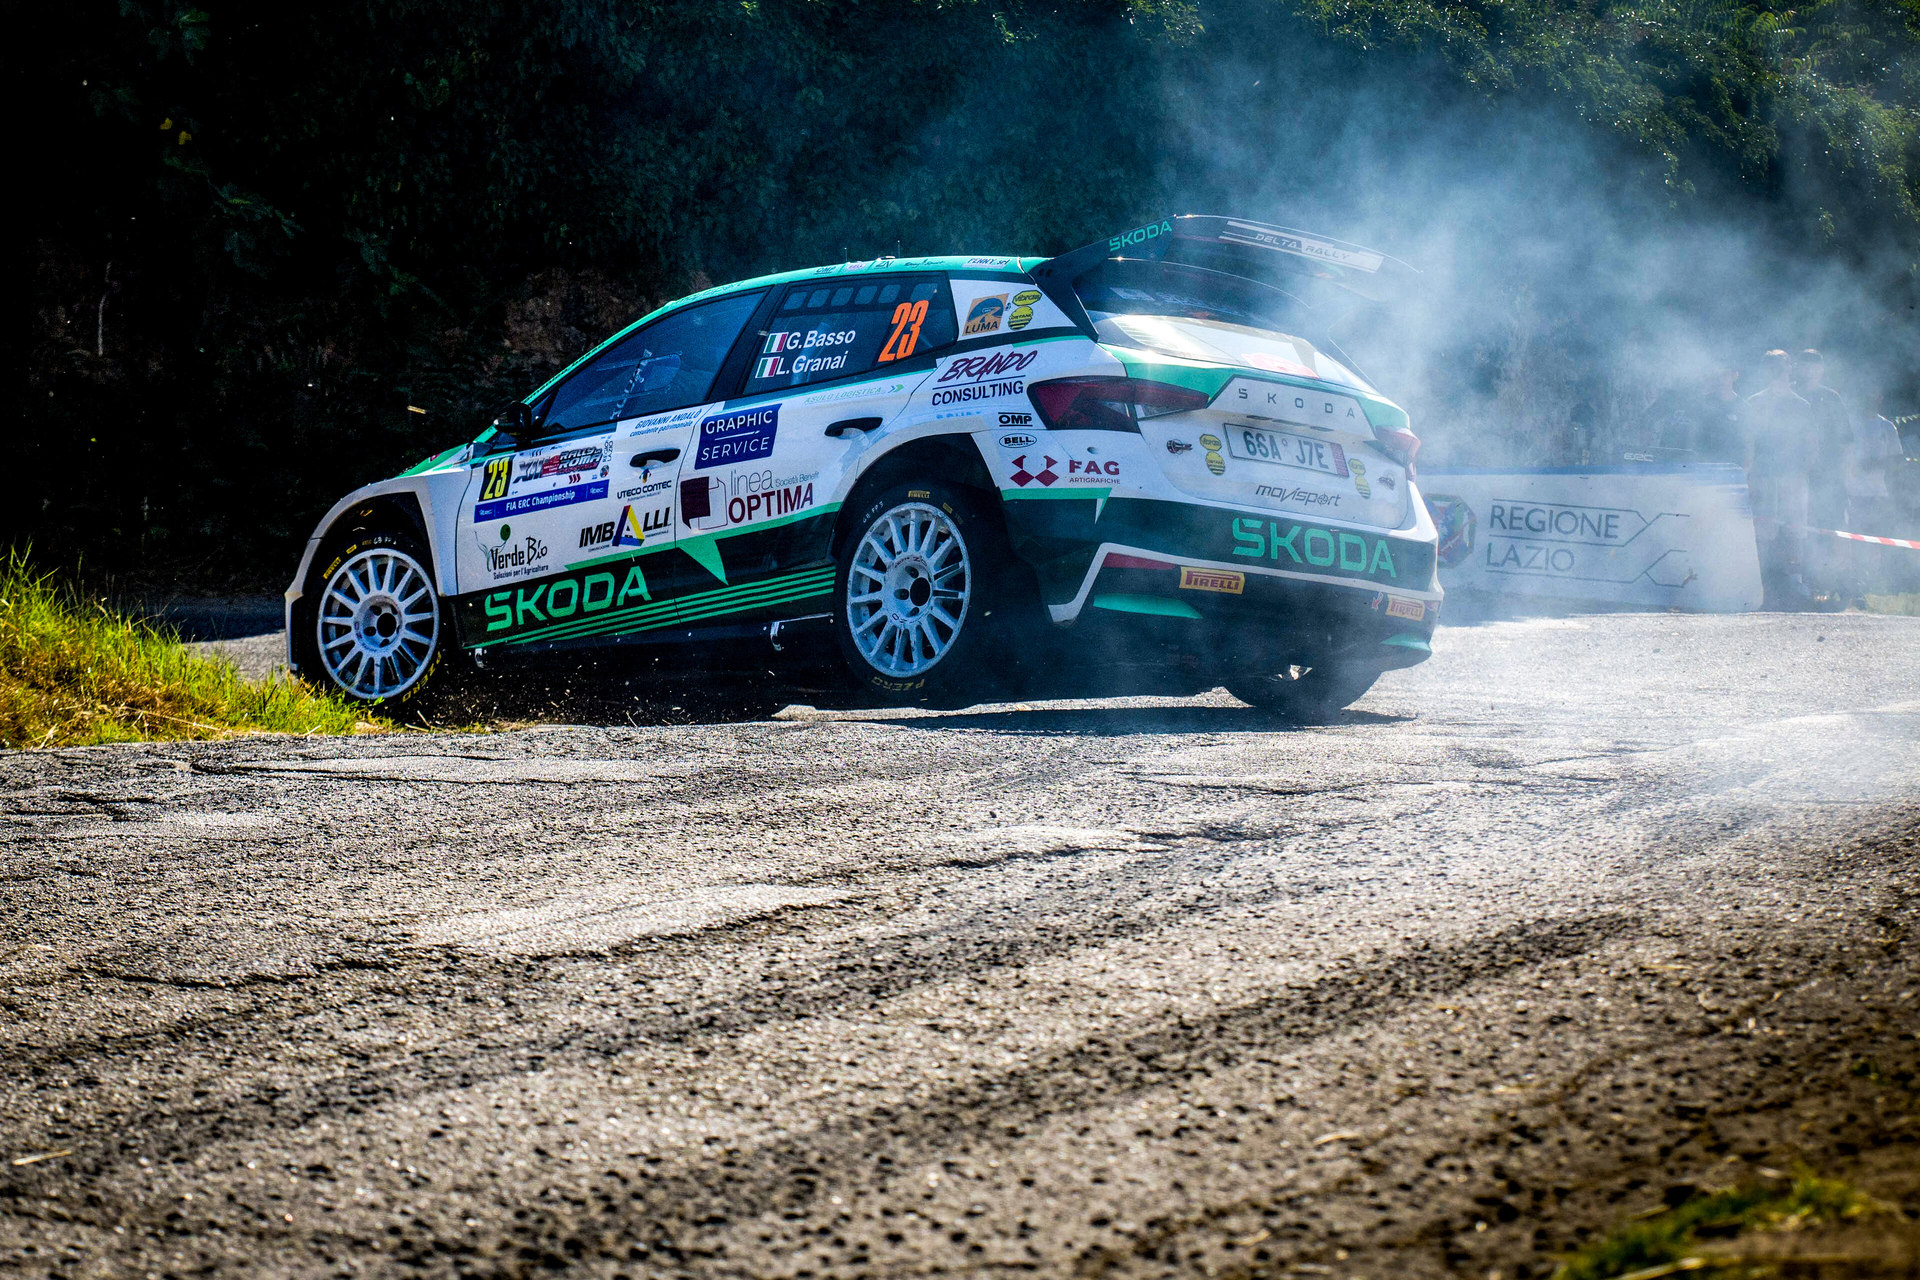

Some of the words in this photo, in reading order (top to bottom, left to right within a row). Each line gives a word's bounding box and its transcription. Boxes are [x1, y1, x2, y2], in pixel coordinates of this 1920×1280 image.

[1108, 220, 1173, 251] SKODA
[1255, 233, 1298, 248] DELTA
[1305, 245, 1351, 260] RALLY
[786, 329, 856, 351] G.Basso
[878, 299, 929, 363] 23
[965, 321, 998, 334] LUMA
[776, 351, 849, 376] L.Granai
[937, 350, 1038, 383] BRANDO
[932, 380, 1024, 406] CONSULTING
[1238, 388, 1356, 419] SKODA
[705, 410, 773, 435] GRAPHIC
[998, 413, 1033, 425] OMP
[560, 446, 597, 461] RALLY
[701, 436, 770, 461] SERVICE
[1004, 436, 1032, 445] BELL
[558, 454, 602, 470] ROMA
[1069, 460, 1120, 475] FAG
[483, 457, 507, 500] 23
[617, 487, 642, 500] UTECO
[642, 480, 672, 494] CONTEC
[731, 469, 773, 496] linea
[505, 501, 517, 511] FIA
[518, 498, 531, 509] ERC
[531, 490, 576, 506] Championship
[728, 482, 813, 523] OPTIMA
[1488, 504, 1620, 540] REGIONE
[490, 544, 525, 570] Verde
[525, 536, 548, 566] Bio
[1232, 517, 1397, 578] SKODA
[1486, 541, 1576, 572] LAZIO
[1185, 570, 1241, 590] PIRELLI
[484, 565, 653, 632] SKODA
